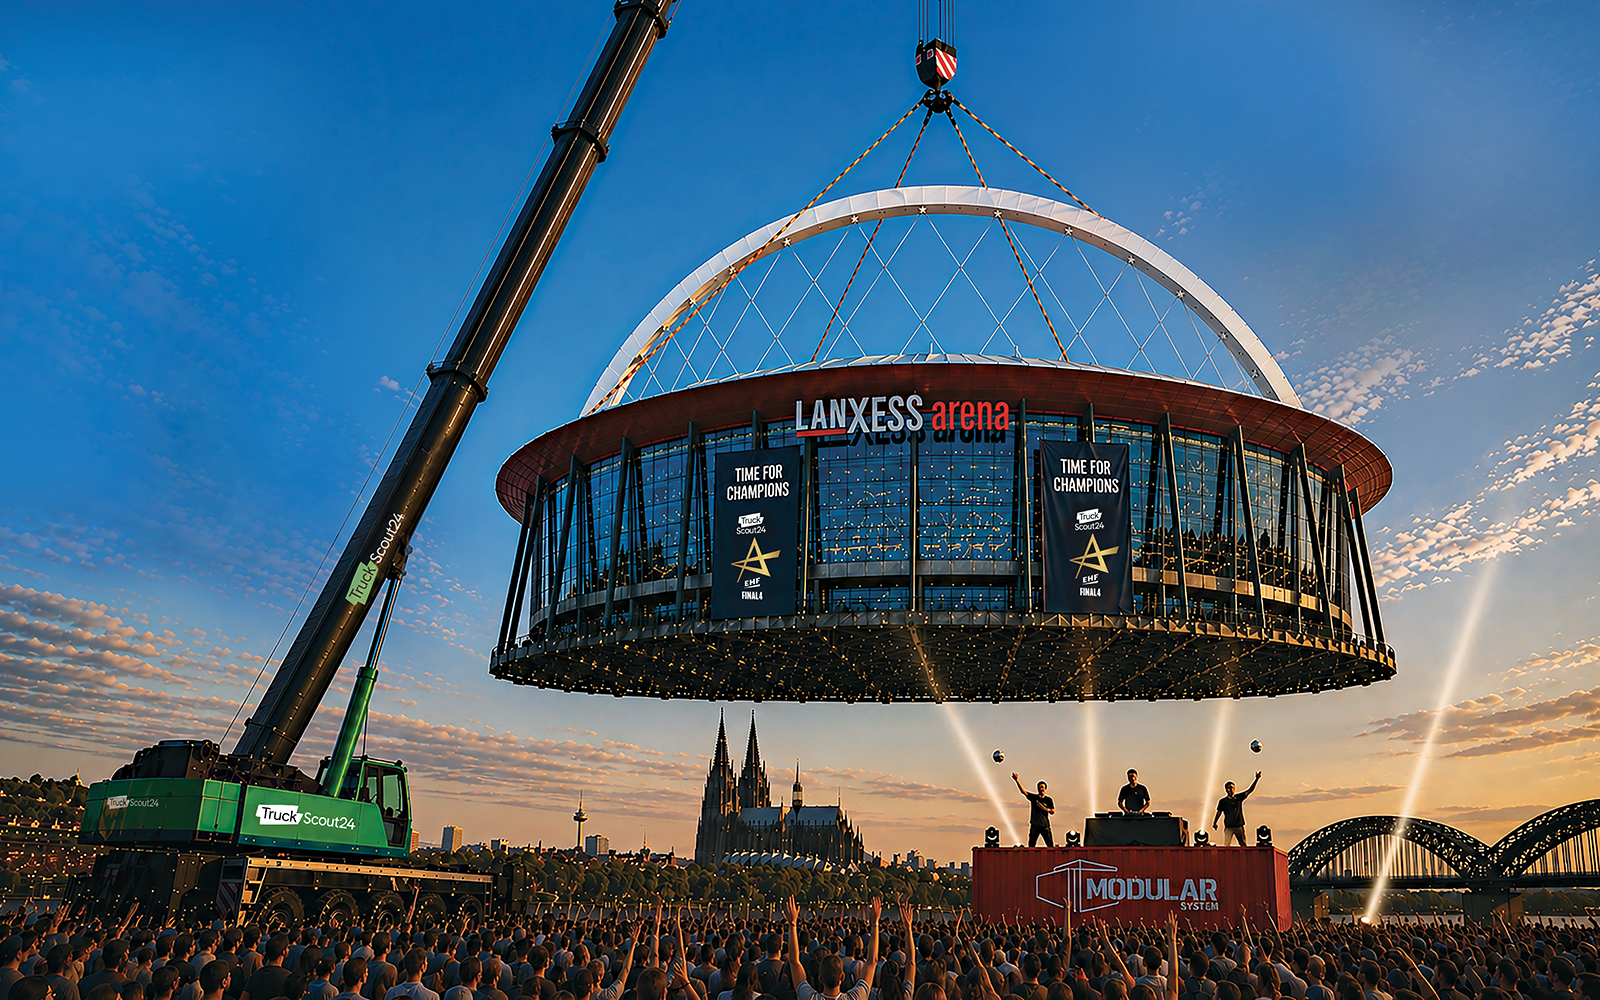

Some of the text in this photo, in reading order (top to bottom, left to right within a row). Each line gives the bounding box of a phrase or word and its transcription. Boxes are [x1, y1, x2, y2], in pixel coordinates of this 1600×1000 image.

[796, 394, 1009, 433] LANXESS arena
[1060, 458, 1111, 475] TIME FOR
[735, 464, 783, 482] TIME FOR
[1053, 477, 1119, 493] CHAMPIONS
[727, 481, 789, 500] CHAMPIONS
[740, 515, 761, 525] Truck
[1079, 511, 1100, 521] Truck
[736, 525, 766, 535] Scout24
[1074, 521, 1104, 531] Scout24
[348, 513, 405, 599] Truck Scout24
[744, 577, 761, 587] EHF
[1082, 573, 1099, 583] EHF
[741, 591, 763, 600] FINAL4
[1079, 587, 1101, 597] FINAL4
[262, 806, 356, 830] Truck Scout24
[1086, 878, 1218, 901] MODULAR
[1180, 902, 1219, 911] SYSTEM
